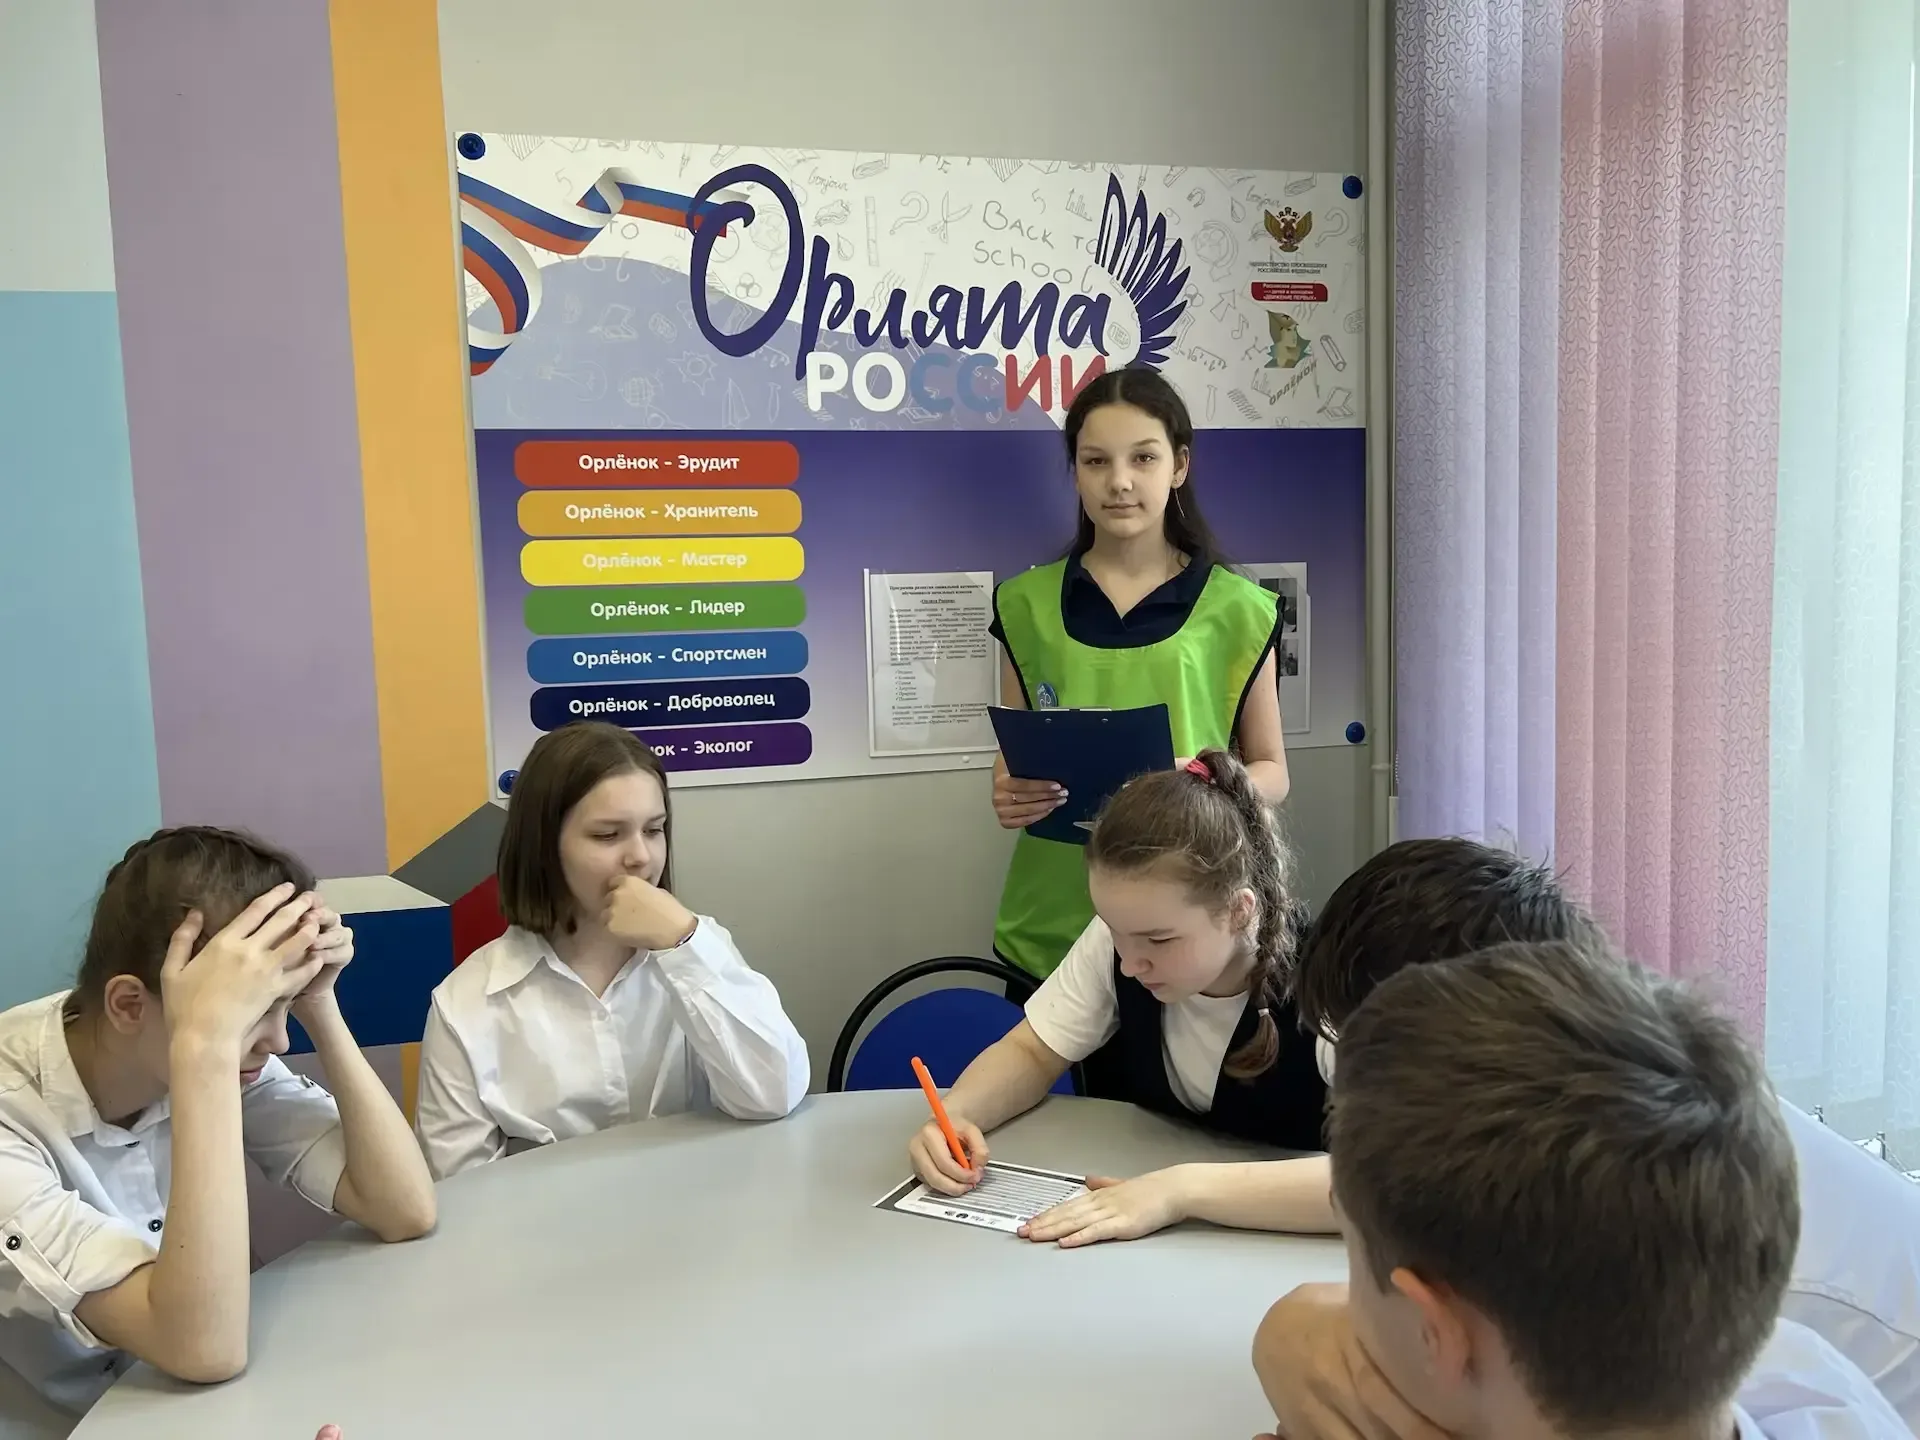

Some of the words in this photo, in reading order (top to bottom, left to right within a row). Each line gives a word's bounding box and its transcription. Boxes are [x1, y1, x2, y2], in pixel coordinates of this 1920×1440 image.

[686, 163, 1112, 382] Орлята
[578, 454, 659, 473] Орлёнок
[677, 455, 740, 473] Эрудит
[564, 504, 646, 523] Орлёнок
[664, 504, 759, 521] Хранитель
[582, 552, 662, 571] Орлёнок
[682, 552, 748, 568] Мастер
[590, 600, 670, 620] Орлёнок
[689, 600, 745, 616] Лидер
[572, 650, 653, 669] Орлёнок
[671, 647, 767, 664] Спортсмен
[568, 698, 649, 717] Орлёнок
[667, 693, 775, 711] Доброволец
[693, 740, 754, 755] Эколог
